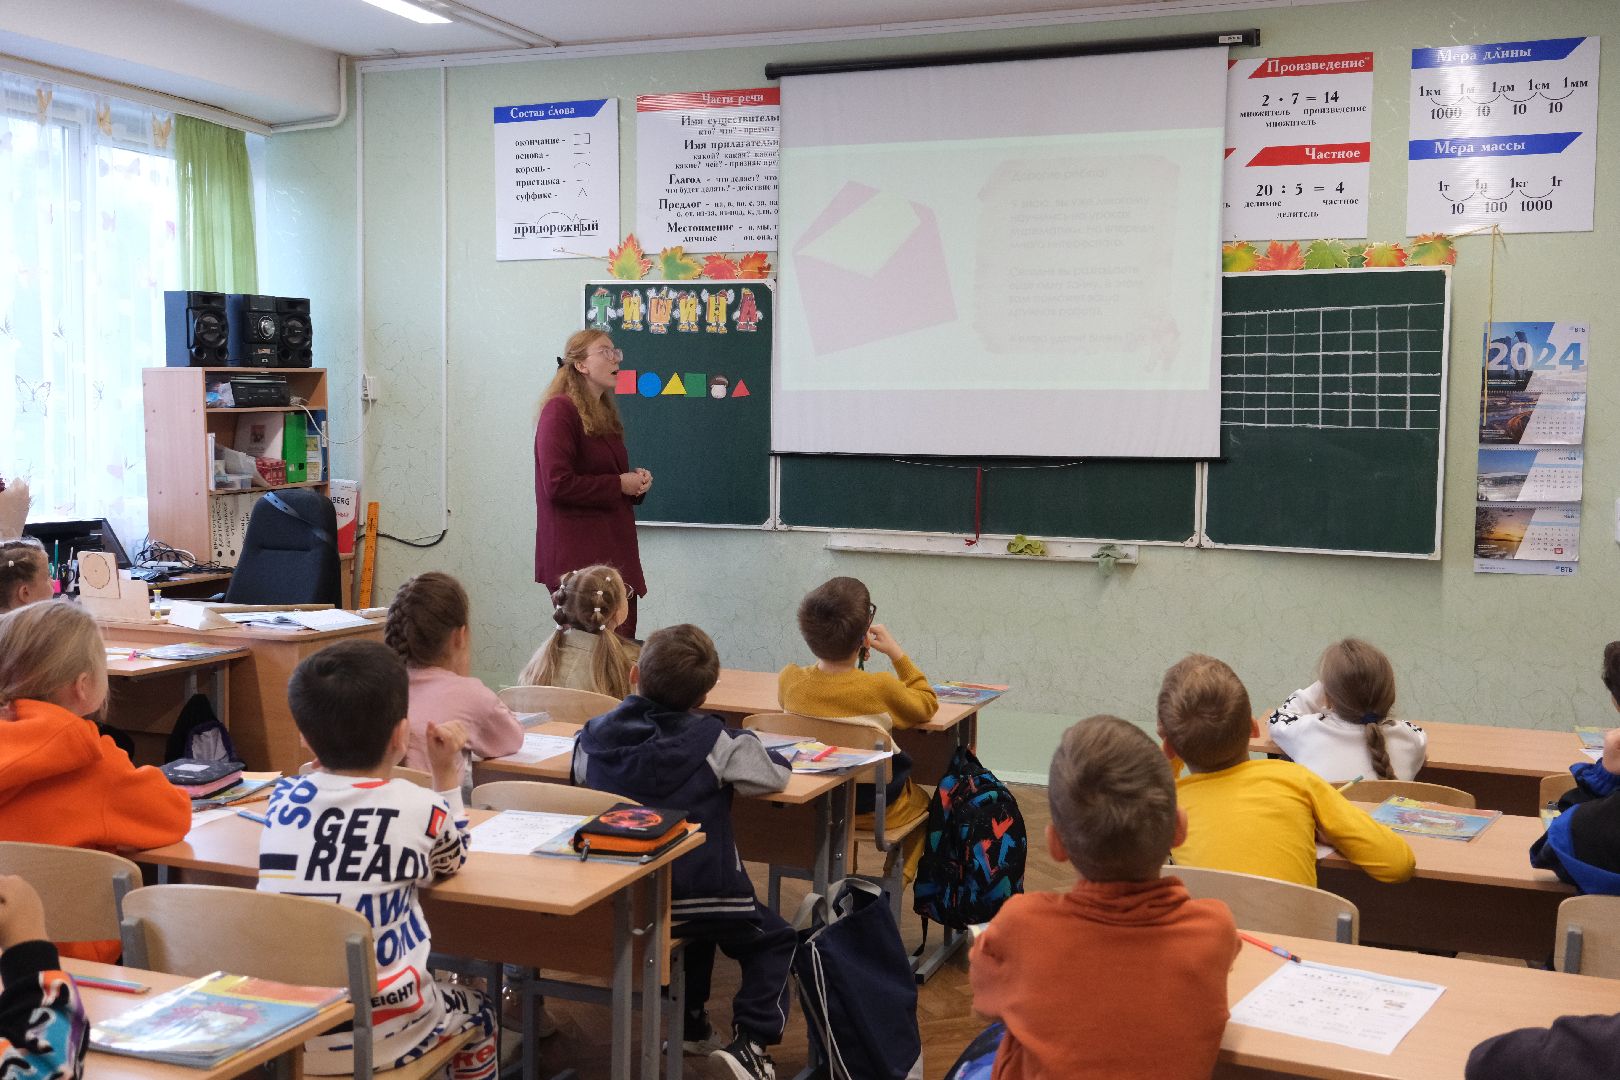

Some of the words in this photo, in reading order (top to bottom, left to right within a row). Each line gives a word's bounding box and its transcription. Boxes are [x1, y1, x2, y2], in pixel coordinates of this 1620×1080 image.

[1437, 49, 1477, 62] Мера
[1483, 47, 1532, 60] длины
[1266, 58, 1365, 74] Произведение
[1419, 86, 1441, 97] 1км
[1492, 82, 1515, 94] 1дм
[1528, 79, 1550, 91] 1см
[1564, 77, 1588, 88] 1мм
[702, 94, 734, 104] Части
[738, 94, 764, 106] речи
[1262, 94, 1270, 107] 2
[1292, 92, 1300, 105] 7
[1324, 90, 1340, 104] 14
[510, 107, 544, 118] Состав
[548, 106, 575, 116] слова
[1240, 110, 1291, 118] множитель
[1303, 105, 1367, 116] произведение
[1430, 106, 1462, 120] 1000
[1476, 105, 1491, 117] 10
[1513, 104, 1527, 116] 10
[1549, 102, 1563, 114] 10
[681, 115, 703, 126] Имя
[1266, 118, 1317, 128] множитель
[698, 128, 716, 136] кто?
[720, 126, 736, 134] что?
[514, 137, 560, 147] окончание
[684, 139, 707, 150] Имя
[1305, 147, 1361, 160] Частное
[1434, 141, 1474, 156] Мера
[1480, 142, 1526, 152] массы
[693, 152, 720, 160] какой?
[730, 160, 761, 168] признак
[516, 166, 546, 176] корень
[516, 178, 560, 188] приставка
[669, 174, 702, 184] Глагол
[1438, 180, 1450, 192] 1т
[1510, 178, 1528, 188] 1кг
[1550, 176, 1562, 187] 1г
[680, 186, 699, 194] будет
[736, 184, 772, 192] действие
[1256, 184, 1273, 197] 20
[1295, 182, 1303, 196] 5
[1335, 181, 1345, 194] 4
[516, 192, 552, 202] суффикс
[658, 198, 702, 211] Предлог
[1244, 200, 1282, 208] делимое
[1451, 203, 1464, 214] 10
[1485, 201, 1508, 213] 100
[1520, 200, 1553, 212] 1000
[1276, 210, 1319, 219] делитель
[513, 220, 599, 237] придорожный
[667, 222, 734, 232] Местоимение
[587, 286, 763, 334] ТИШИНА
[1487, 342, 1585, 371] 2024
[313, 807, 400, 846] GET
